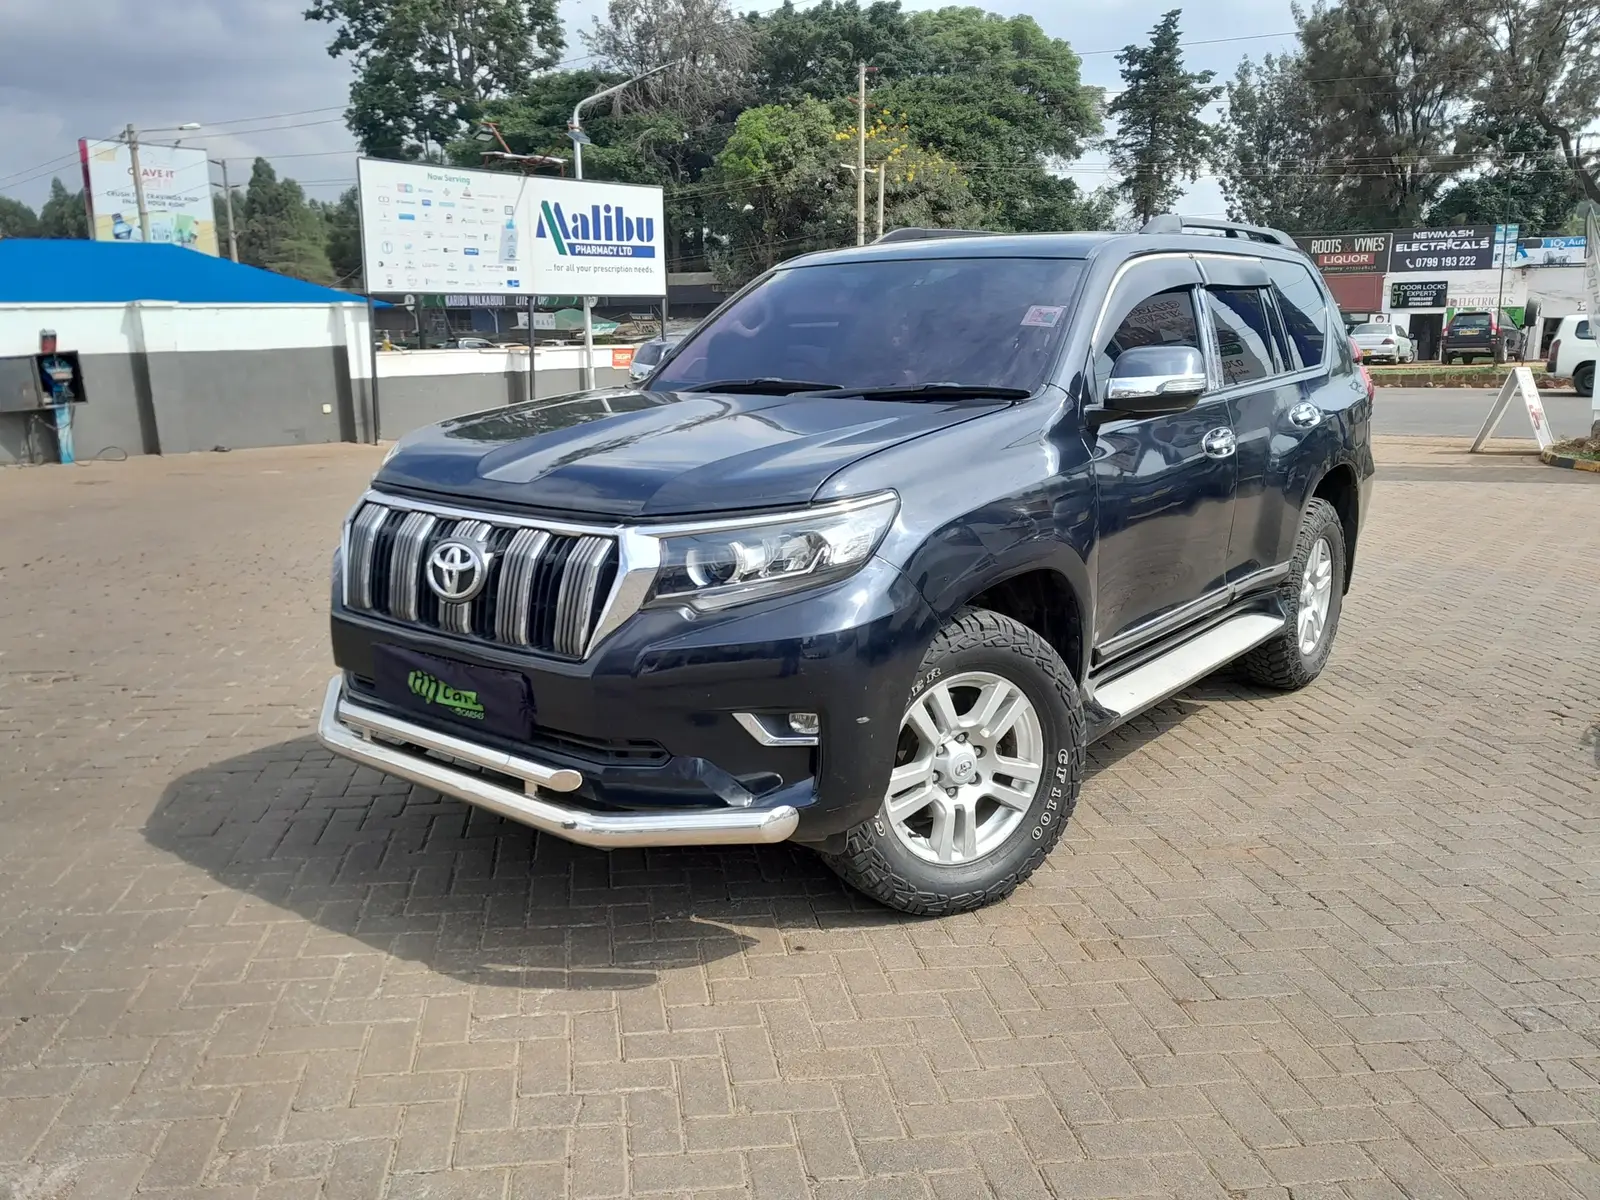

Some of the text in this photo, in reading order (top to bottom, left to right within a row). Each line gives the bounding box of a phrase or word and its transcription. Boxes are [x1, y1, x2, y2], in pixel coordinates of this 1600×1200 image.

[127, 167, 175, 178] CAVE IT
[427, 172, 471, 185] Now Serving
[106, 190, 130, 198] CRUSH
[146, 193, 182, 203] CRAVINGS
[536, 200, 654, 256] Malibu
[1412, 229, 1475, 239] NEWMASH
[575, 244, 633, 256] PHARMACY LTD
[1311, 237, 1385, 254] ROOTS & VYNES
[1395, 239, 1490, 253] ELECTRICALS
[1324, 254, 1369, 264] LIQUOR
[1415, 255, 1477, 268] 0799 193 222
[566, 264, 575, 272] all
[576, 265, 591, 274] your
[593, 265, 633, 274] prescription
[634, 265, 655, 273] needs.
[1459, 296, 1514, 306] ELECTRICLS
